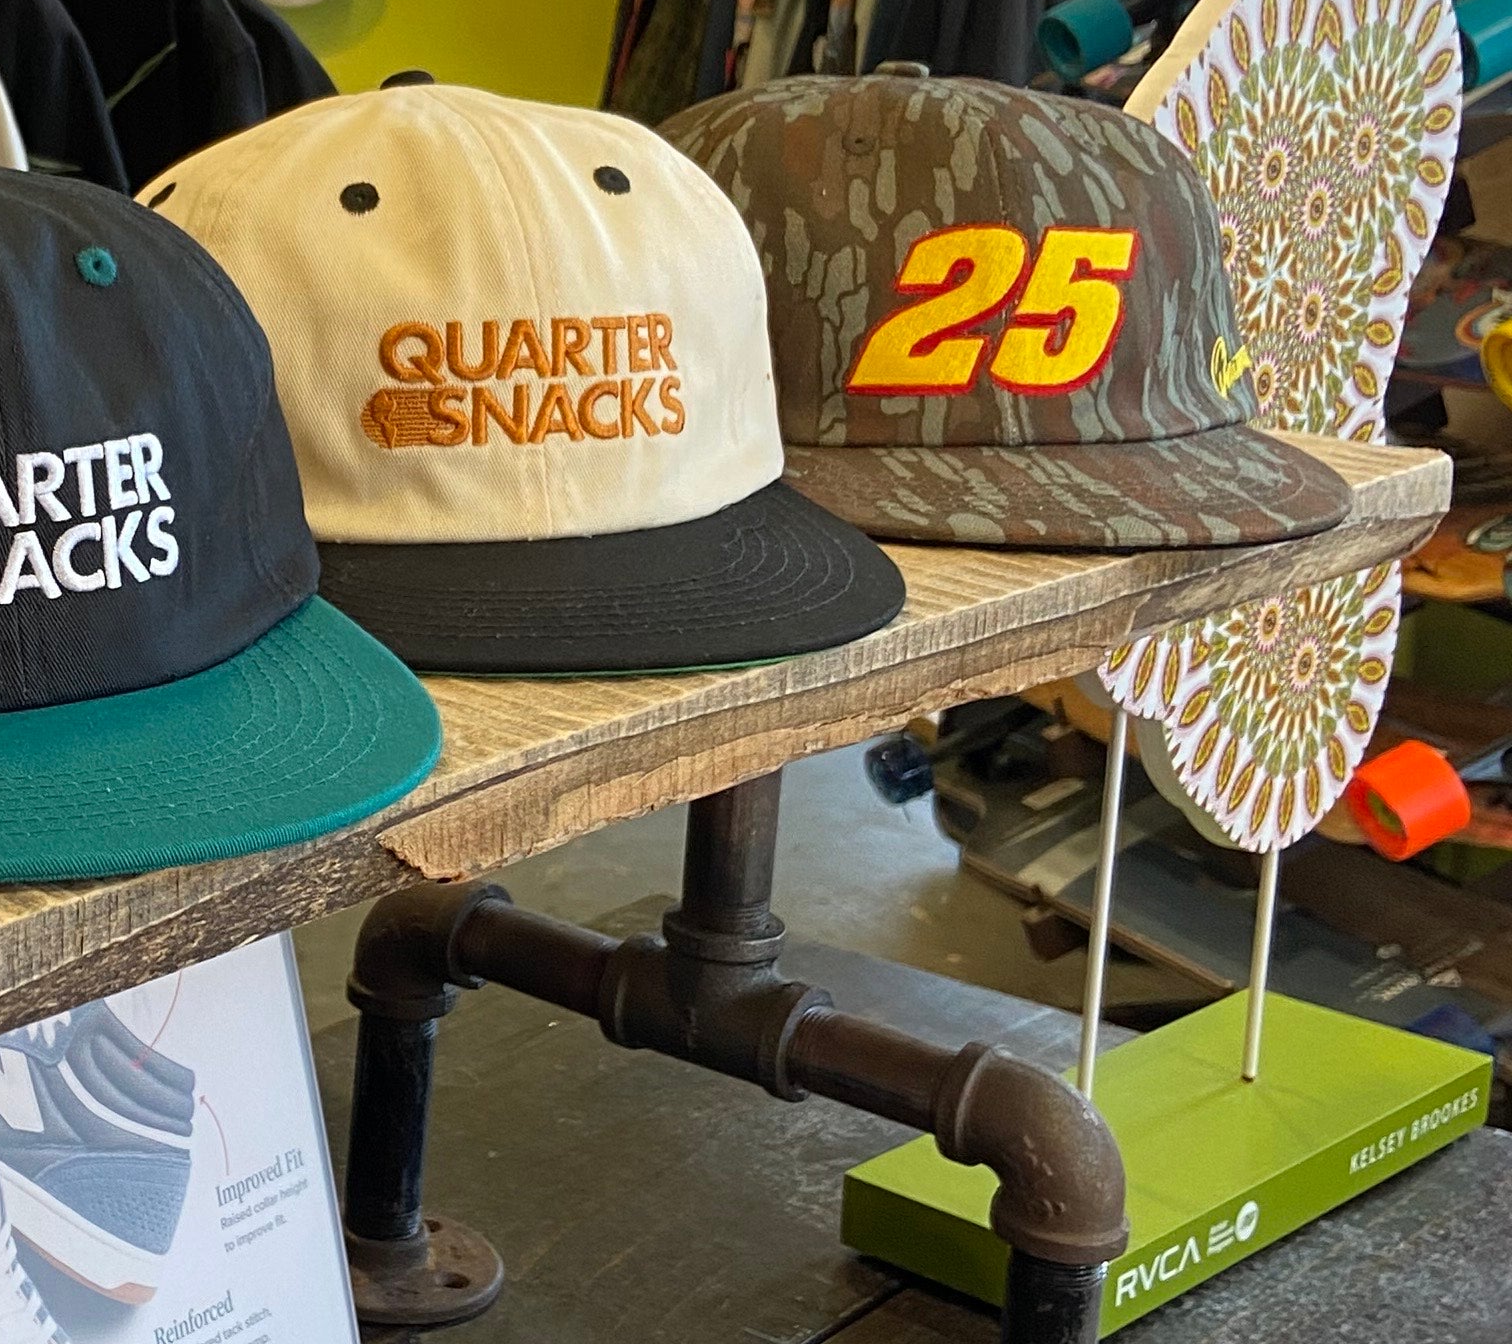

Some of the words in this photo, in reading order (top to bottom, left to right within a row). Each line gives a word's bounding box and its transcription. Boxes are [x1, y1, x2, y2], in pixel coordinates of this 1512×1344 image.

[846, 222, 1141, 397] 25
[378, 313, 678, 386] QUARTER
[427, 375, 686, 447] SNACKS
[1349, 1125, 1408, 1175] KELSEY
[1409, 1087, 1480, 1143] BROOKES
[215, 1155, 284, 1208] Improved
[284, 1148, 305, 1173] Fit
[220, 1205, 253, 1230] Raised
[253, 1194, 279, 1214] collar
[279, 1178, 308, 1200] height
[235, 1221, 275, 1246] improve
[1114, 1235, 1203, 1308] RVCA
[223, 1321, 244, 1341] tack
